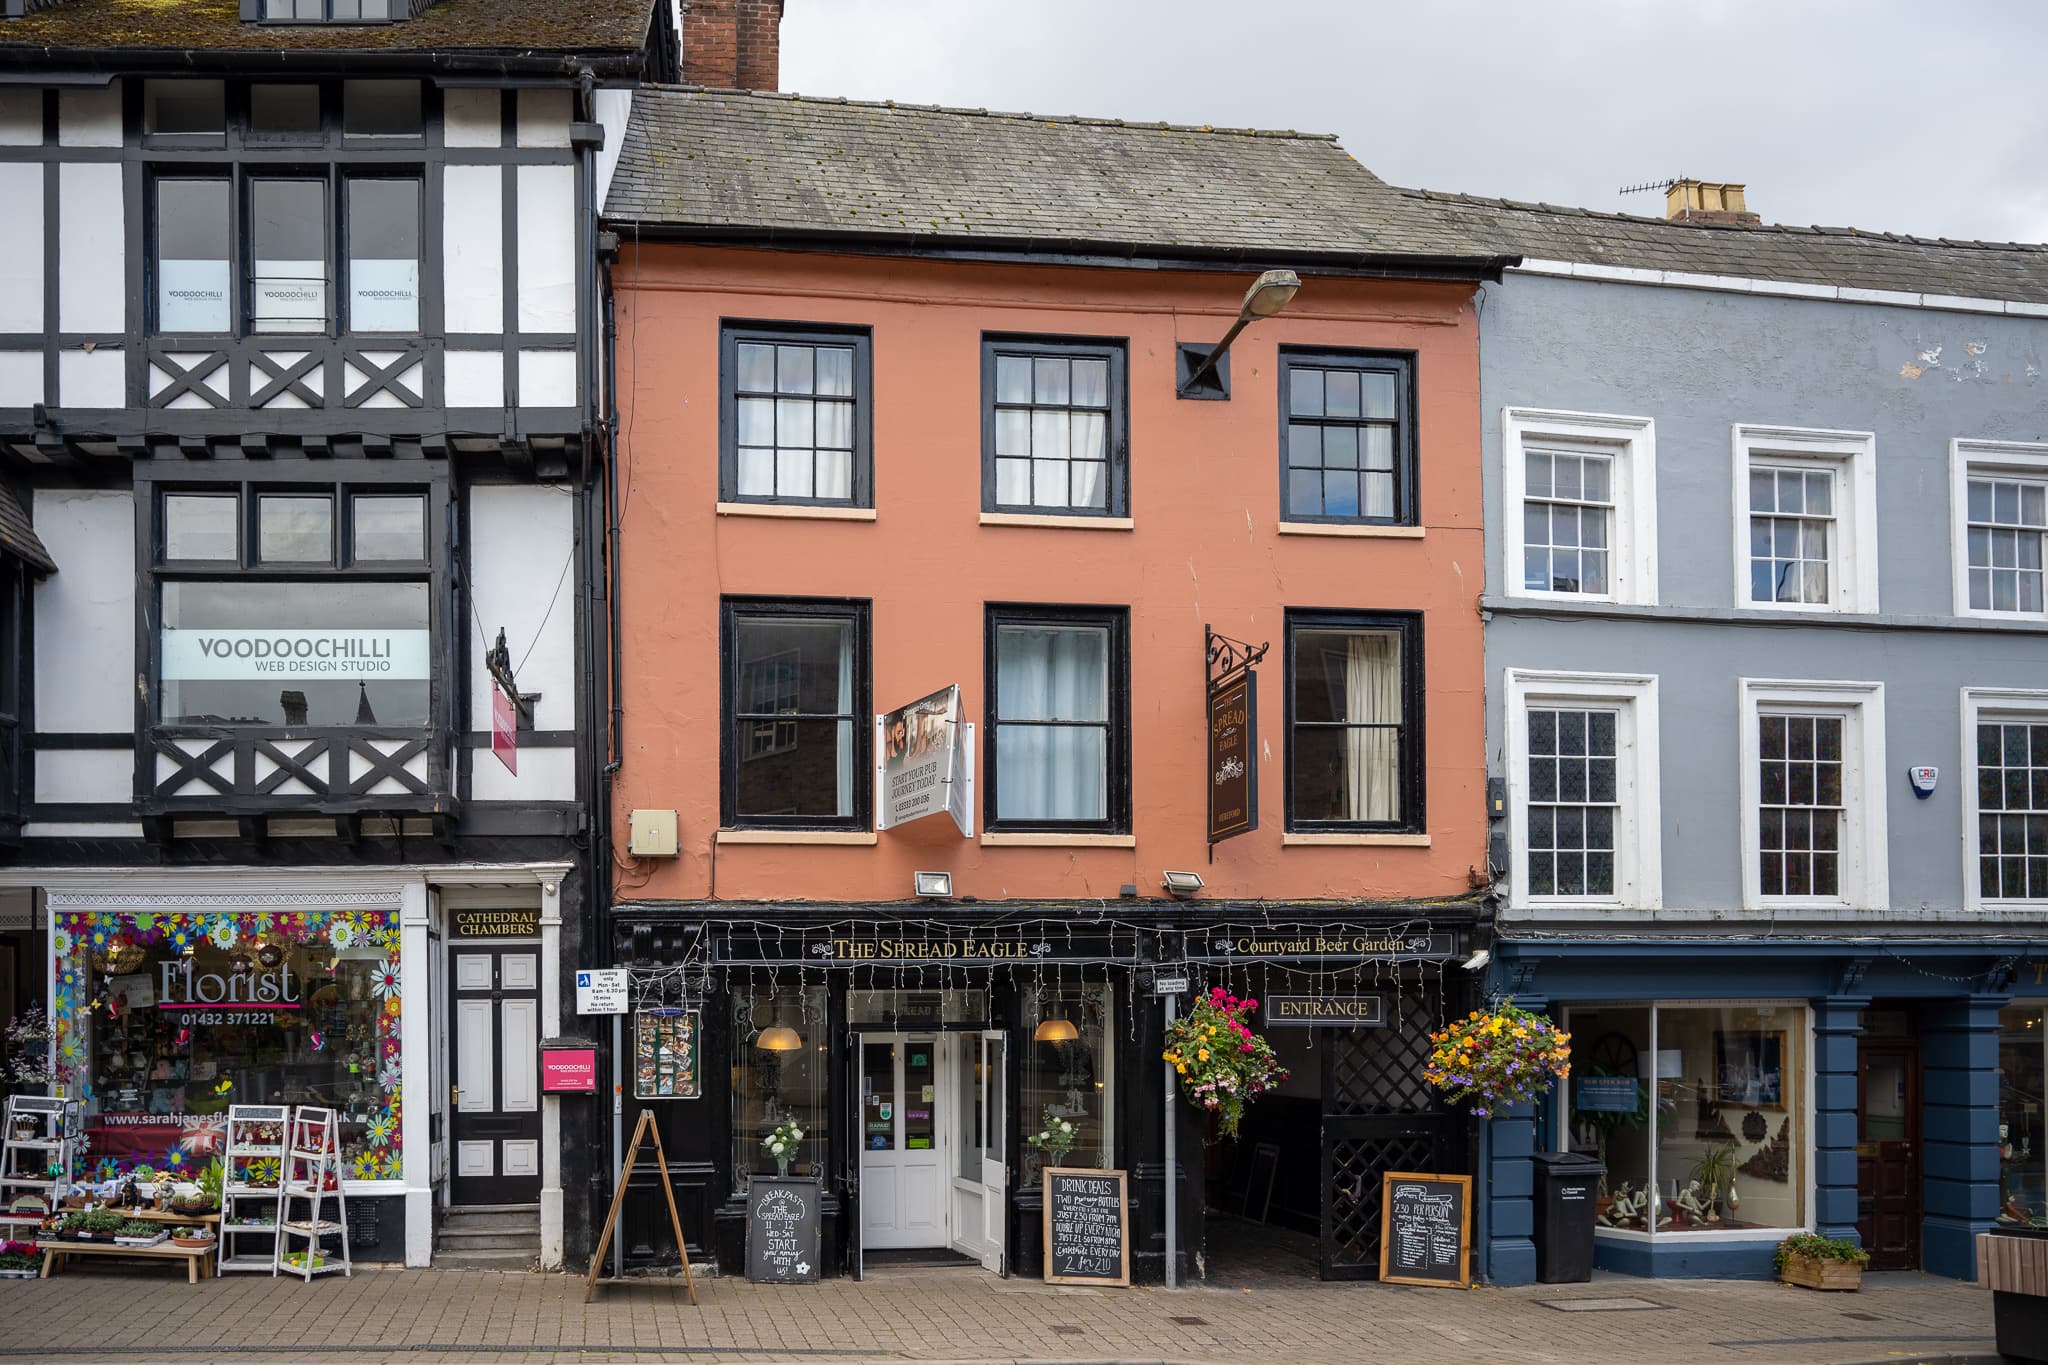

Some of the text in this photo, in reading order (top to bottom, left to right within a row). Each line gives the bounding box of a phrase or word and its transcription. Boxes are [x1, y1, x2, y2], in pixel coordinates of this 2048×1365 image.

[198, 638, 391, 658] VOODOOCHILLI
[255, 661, 391, 672] WEB DESIGN STUDIO
[1213, 709, 1245, 737] SPREAD
[892, 761, 937, 787] START YOUR PUB
[917, 773, 937, 790] TODAY
[456, 912, 537, 924] CATHEDRAL
[460, 923, 534, 935] CHAMBERS
[834, 939, 1029, 958] THE SPREAD EAGLE
[1237, 937, 1406, 956] Courtyard Beer Garden
[158, 958, 300, 1003] Florist
[1280, 1001, 1368, 1016] ENTRANCE
[181, 1012, 275, 1025] 01432 371221
[1061, 1178, 1112, 1195] DRINK DEALS
[760, 1188, 805, 1206] BREAKFAST
[1055, 1194, 1072, 1205] TWO
[771, 1205, 788, 1214] THE
[761, 1212, 784, 1221] SPREAD
[1056, 1210, 1073, 1219] JUST
[1088, 1213, 1105, 1223] FROM
[784, 1220, 795, 1229] 12
[1074, 1223, 1084, 1234] UP
[1084, 1224, 1105, 1236] EVERY
[768, 1238, 798, 1250] START
[1057, 1233, 1073, 1242] JUST
[1090, 1236, 1105, 1245] FROM
[1089, 1247, 1109, 1256] EVERY
[1109, 1249, 1120, 1258] DAY
[773, 1256, 791, 1266] WITH
[1065, 1256, 1076, 1270] 2
